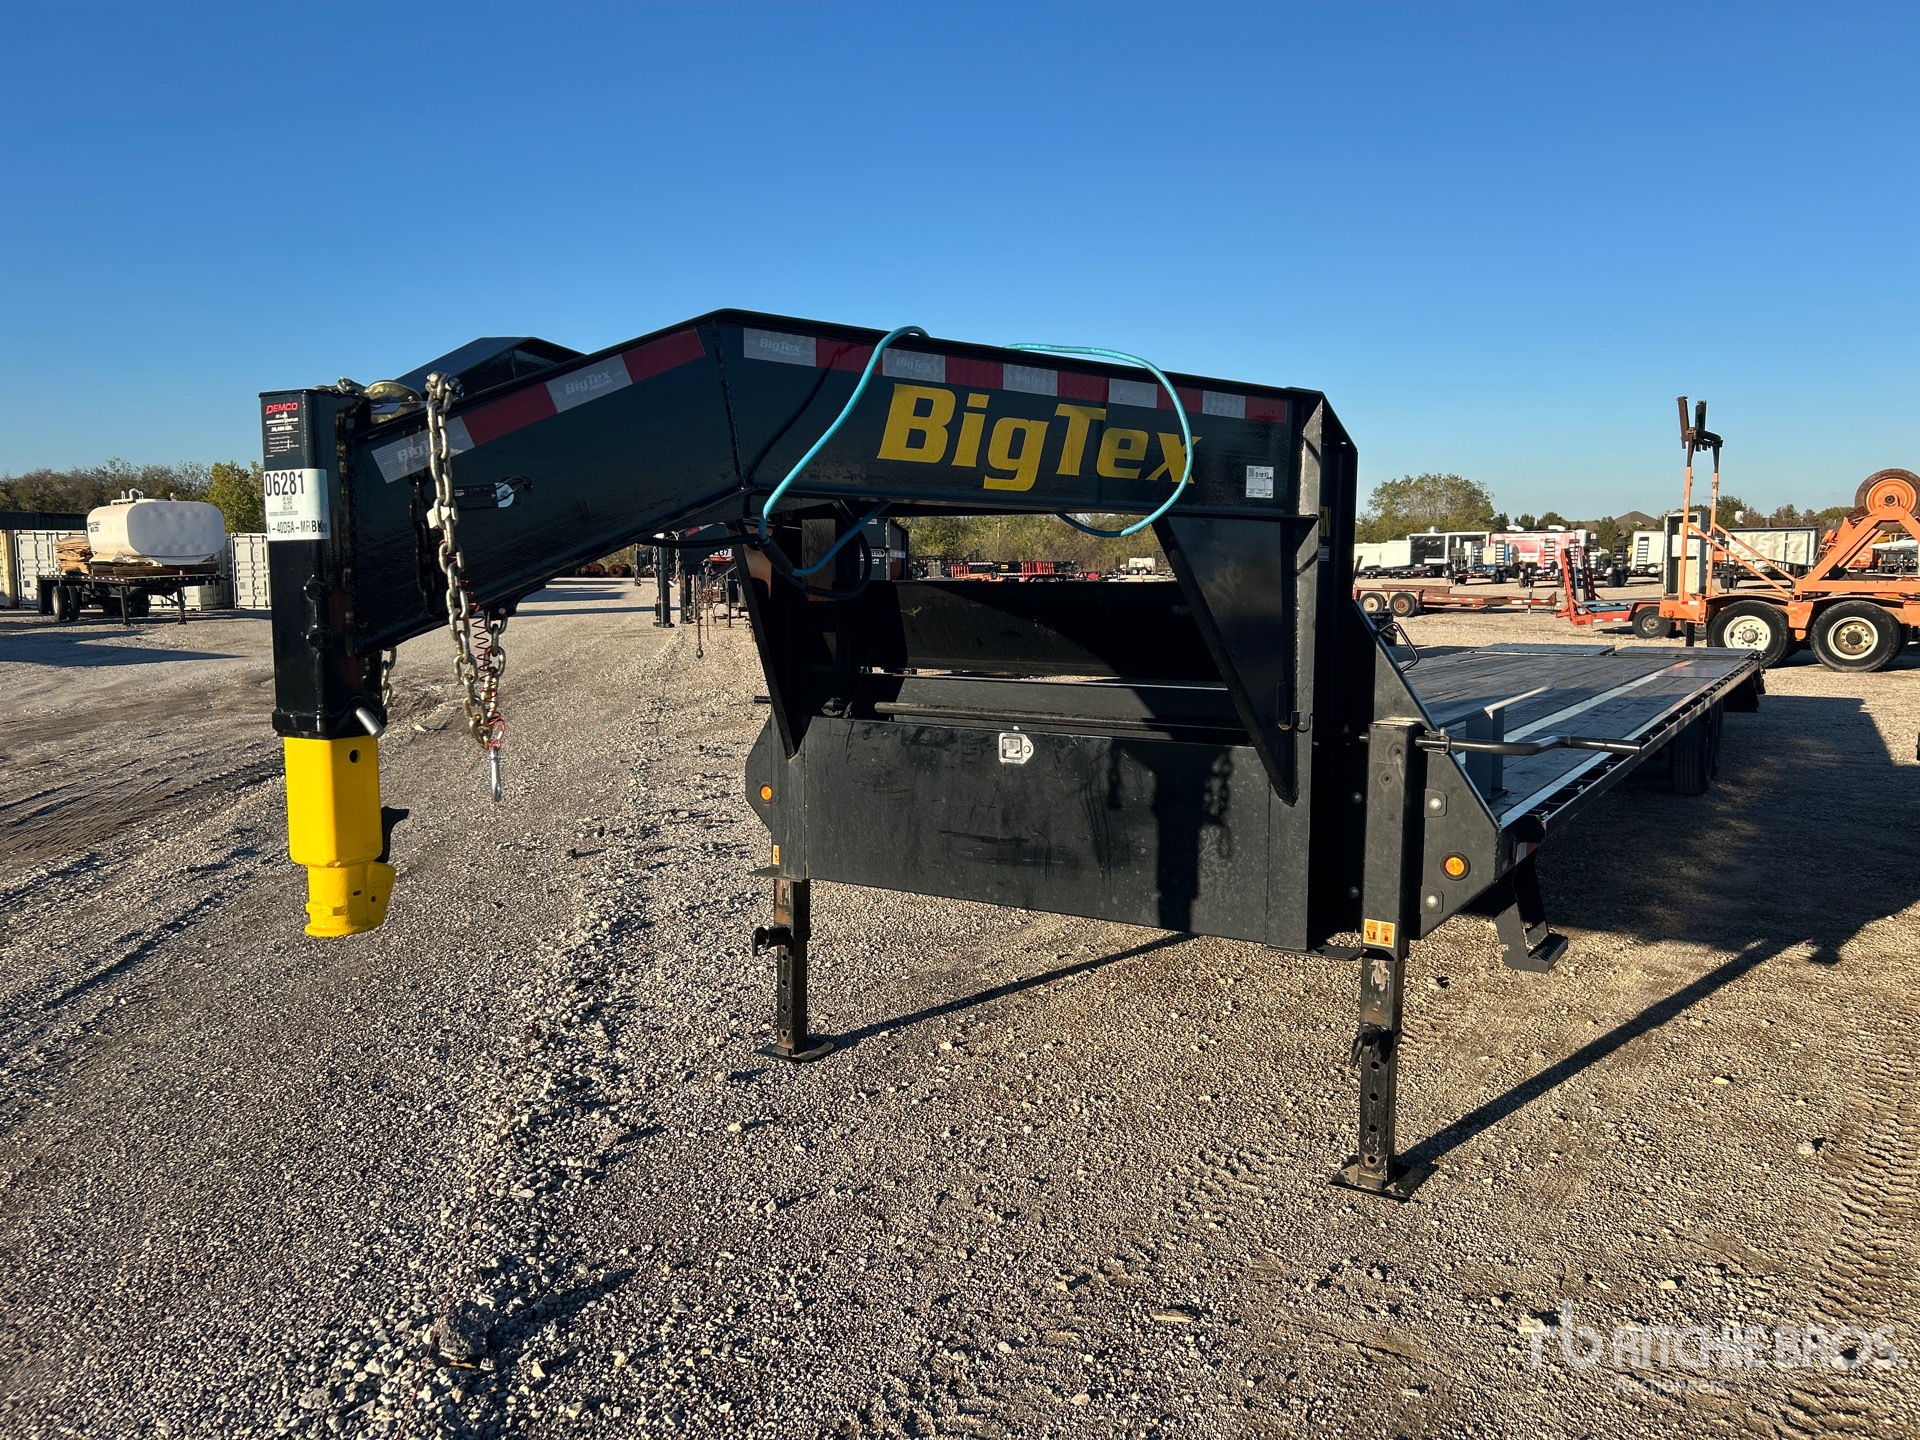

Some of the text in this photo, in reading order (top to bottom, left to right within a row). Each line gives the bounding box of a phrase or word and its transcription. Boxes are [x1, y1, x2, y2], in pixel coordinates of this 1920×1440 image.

[760, 338, 800, 352] BigTex
[896, 356, 931, 369] BigTex
[565, 371, 611, 394] BigTex
[265, 402, 298, 415] DEMCO
[876, 383, 1203, 491] BigTex
[265, 471, 304, 497] 06281
